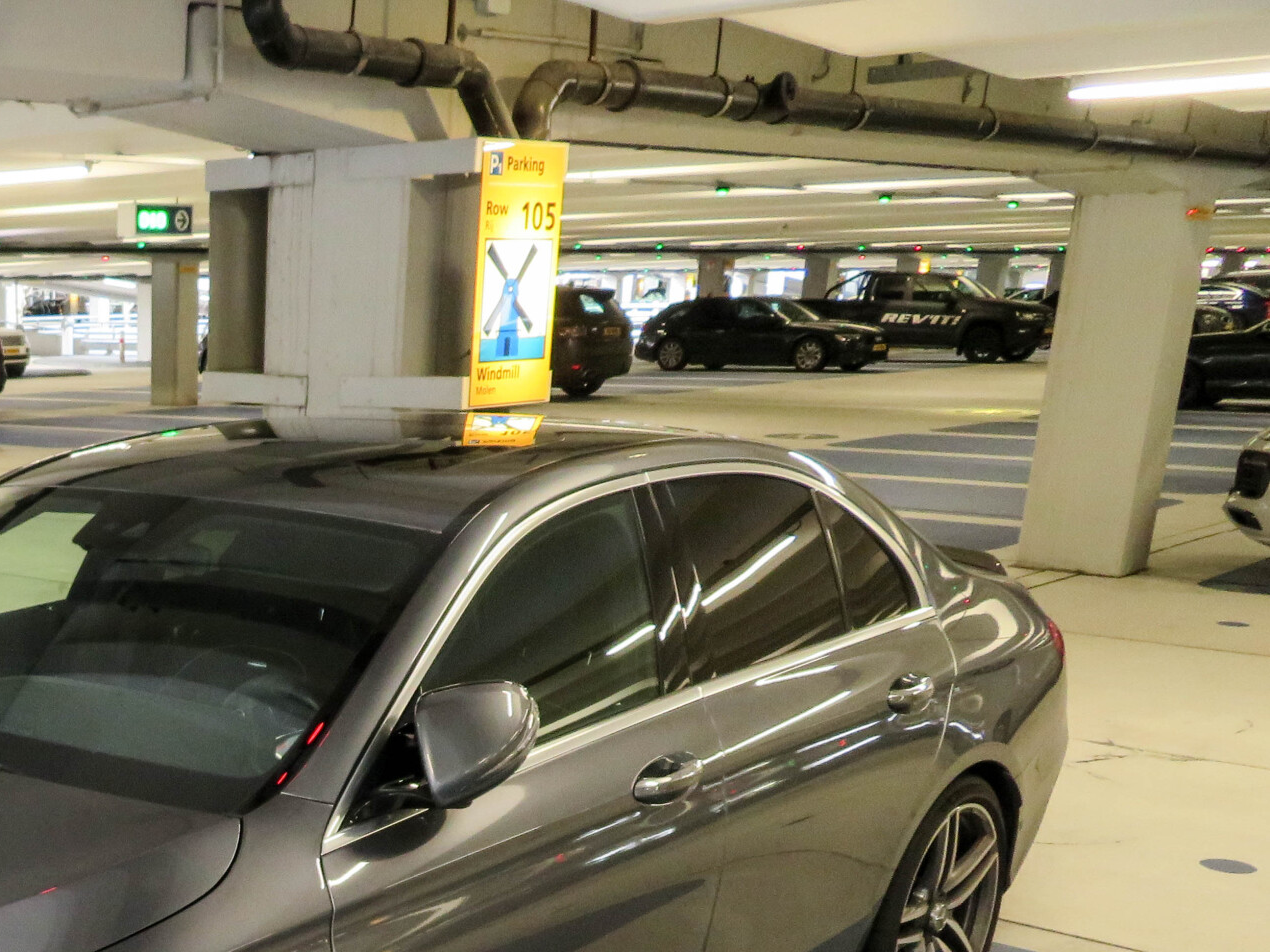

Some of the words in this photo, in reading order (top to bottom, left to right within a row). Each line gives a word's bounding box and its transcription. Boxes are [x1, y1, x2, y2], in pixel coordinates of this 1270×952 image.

[507, 156, 545, 176] Parking
[486, 201, 509, 215] Row
[522, 202, 556, 231] 105
[476, 364, 520, 381] Windmill
